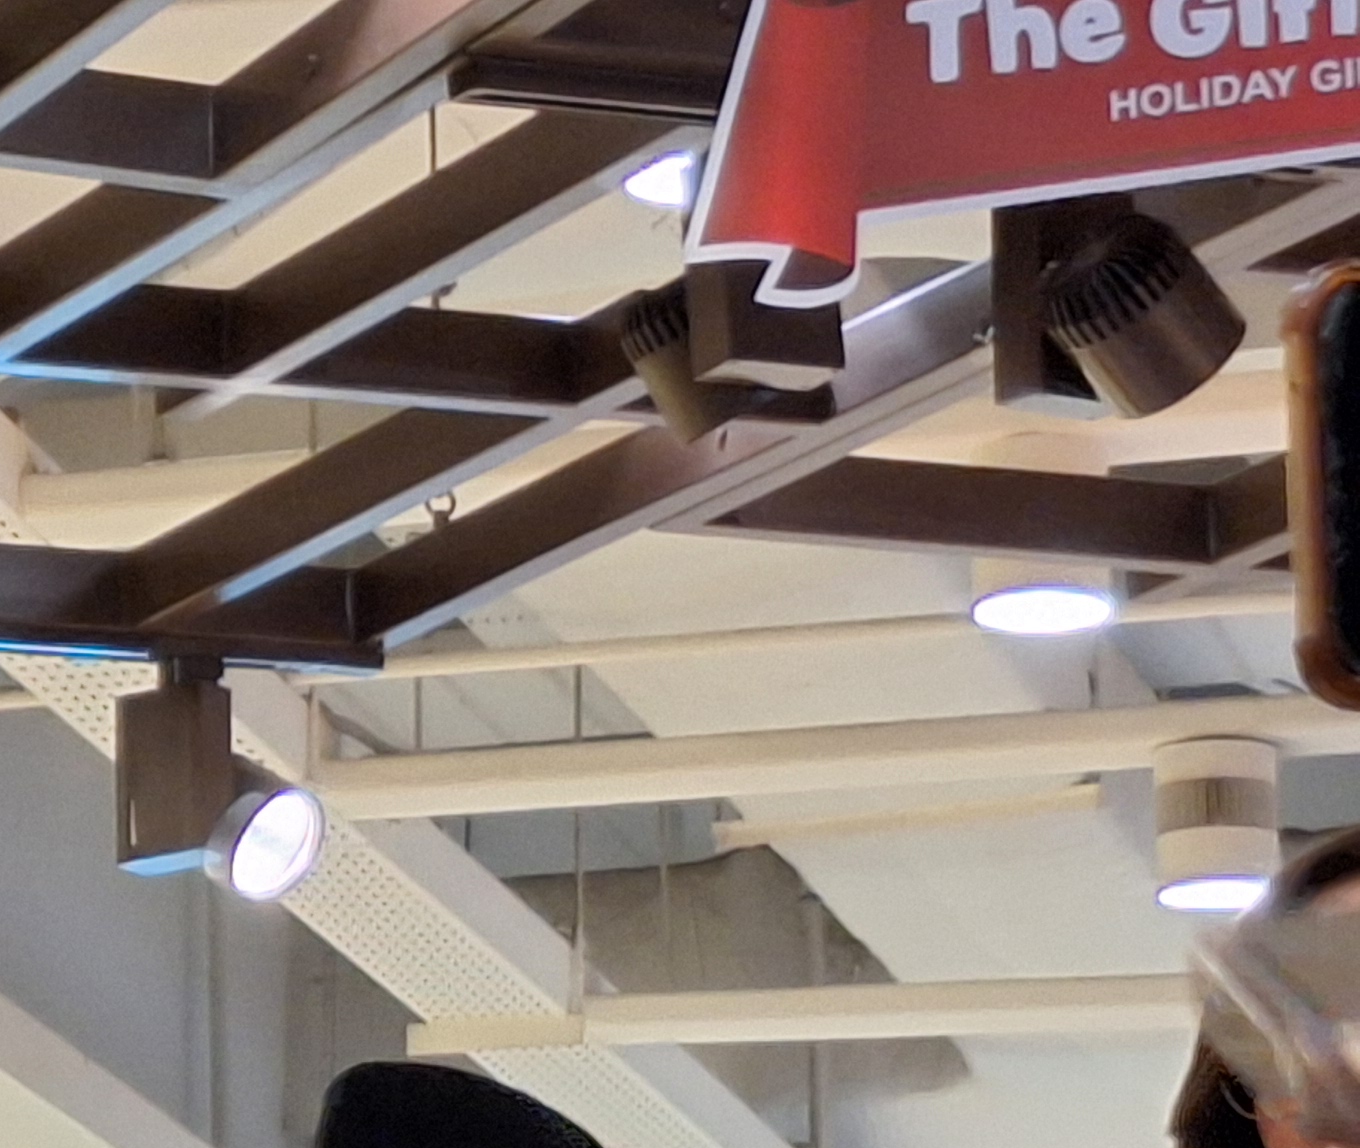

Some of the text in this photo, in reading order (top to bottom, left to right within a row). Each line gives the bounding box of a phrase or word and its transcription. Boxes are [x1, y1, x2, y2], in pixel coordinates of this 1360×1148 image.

[905, 0, 1127, 84] The
[1109, 57, 1360, 122] HOLIDAY GI
